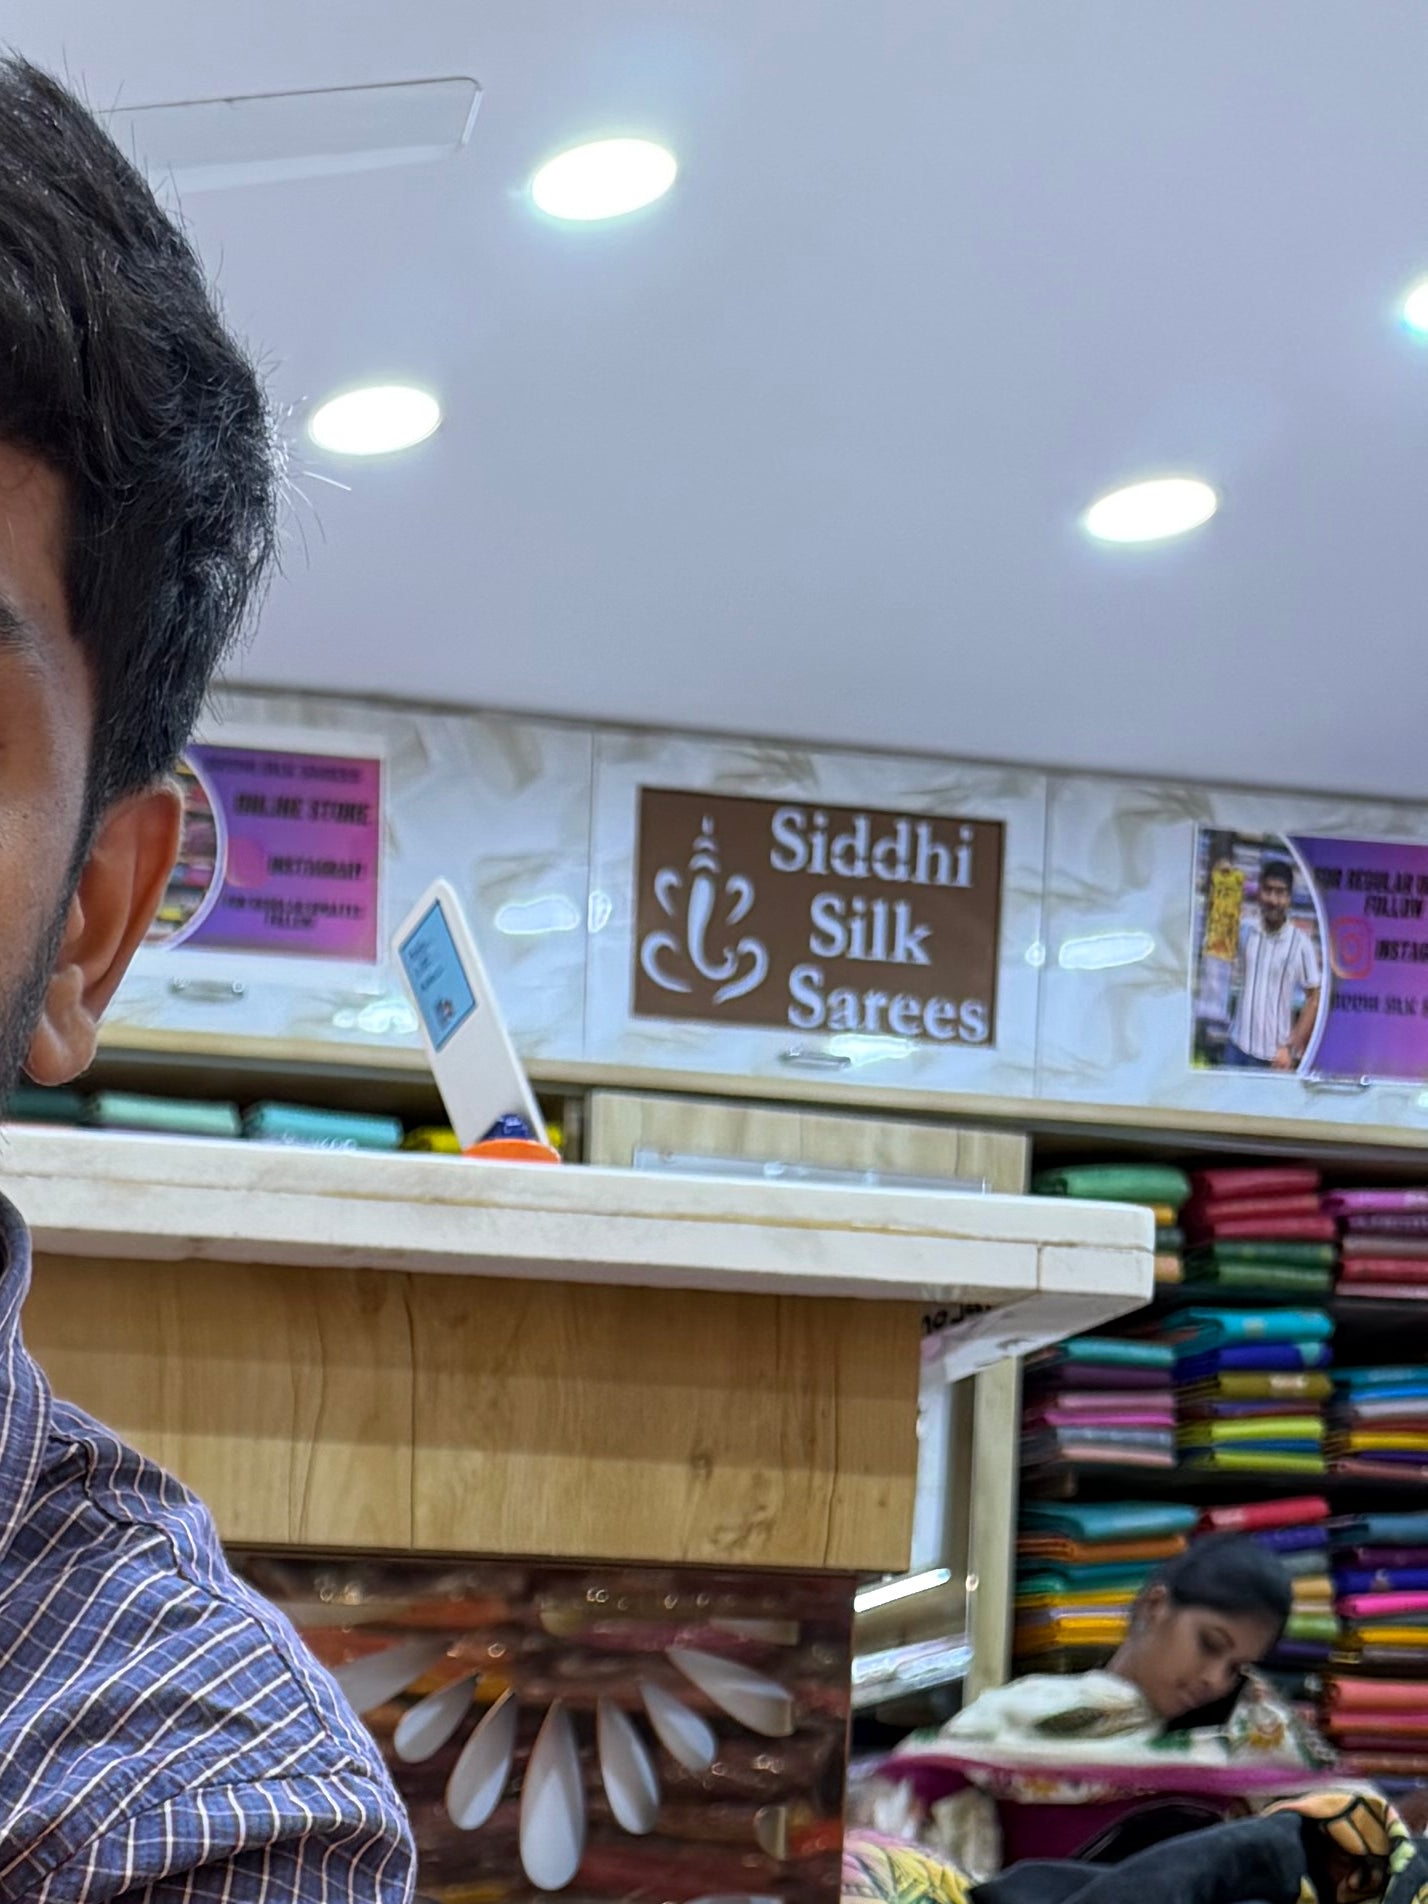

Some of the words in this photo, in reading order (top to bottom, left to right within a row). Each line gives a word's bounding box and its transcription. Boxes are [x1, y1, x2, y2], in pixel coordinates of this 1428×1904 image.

[770, 805, 973, 888] Siddhi
[809, 891, 932, 965] Silk
[788, 963, 988, 1043] Sarees
